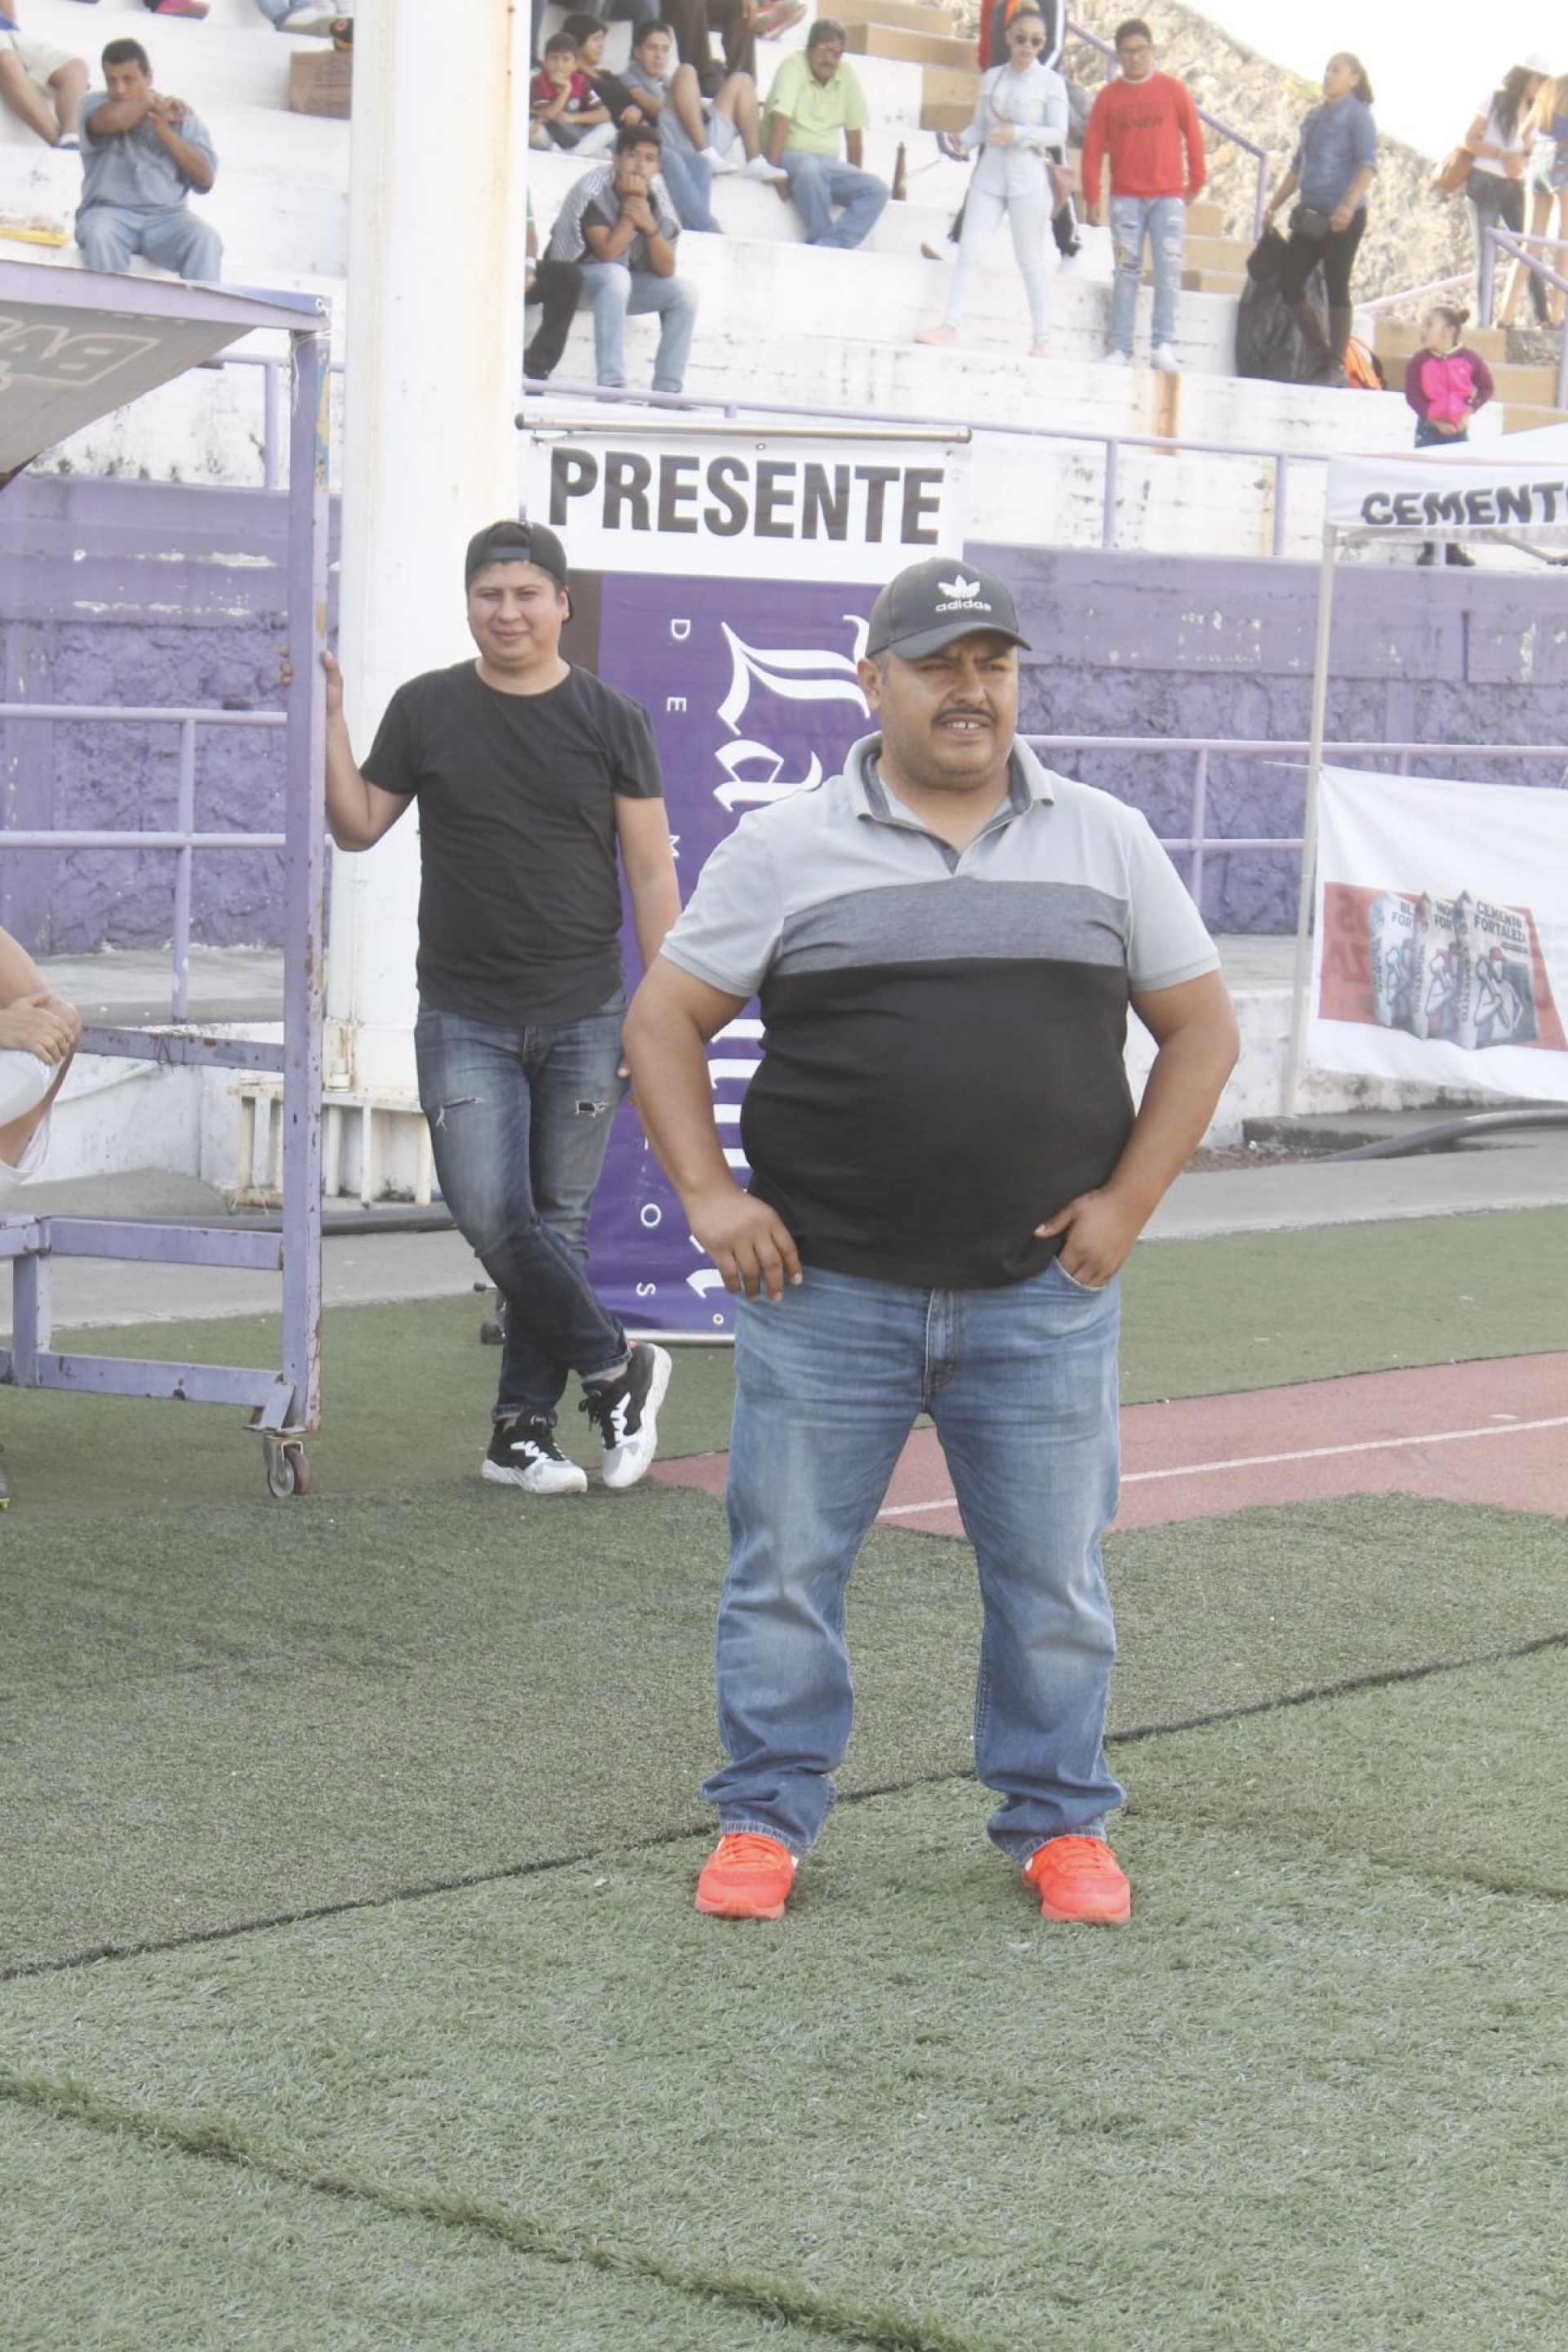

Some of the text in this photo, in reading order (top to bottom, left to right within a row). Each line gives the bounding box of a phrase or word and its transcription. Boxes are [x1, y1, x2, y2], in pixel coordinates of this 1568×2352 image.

[550, 447, 945, 546] PRESENTE
[1361, 481, 1568, 525] CEMENT
[936, 599, 991, 612] adidas
[1477, 901, 1523, 929] CEMENTO
